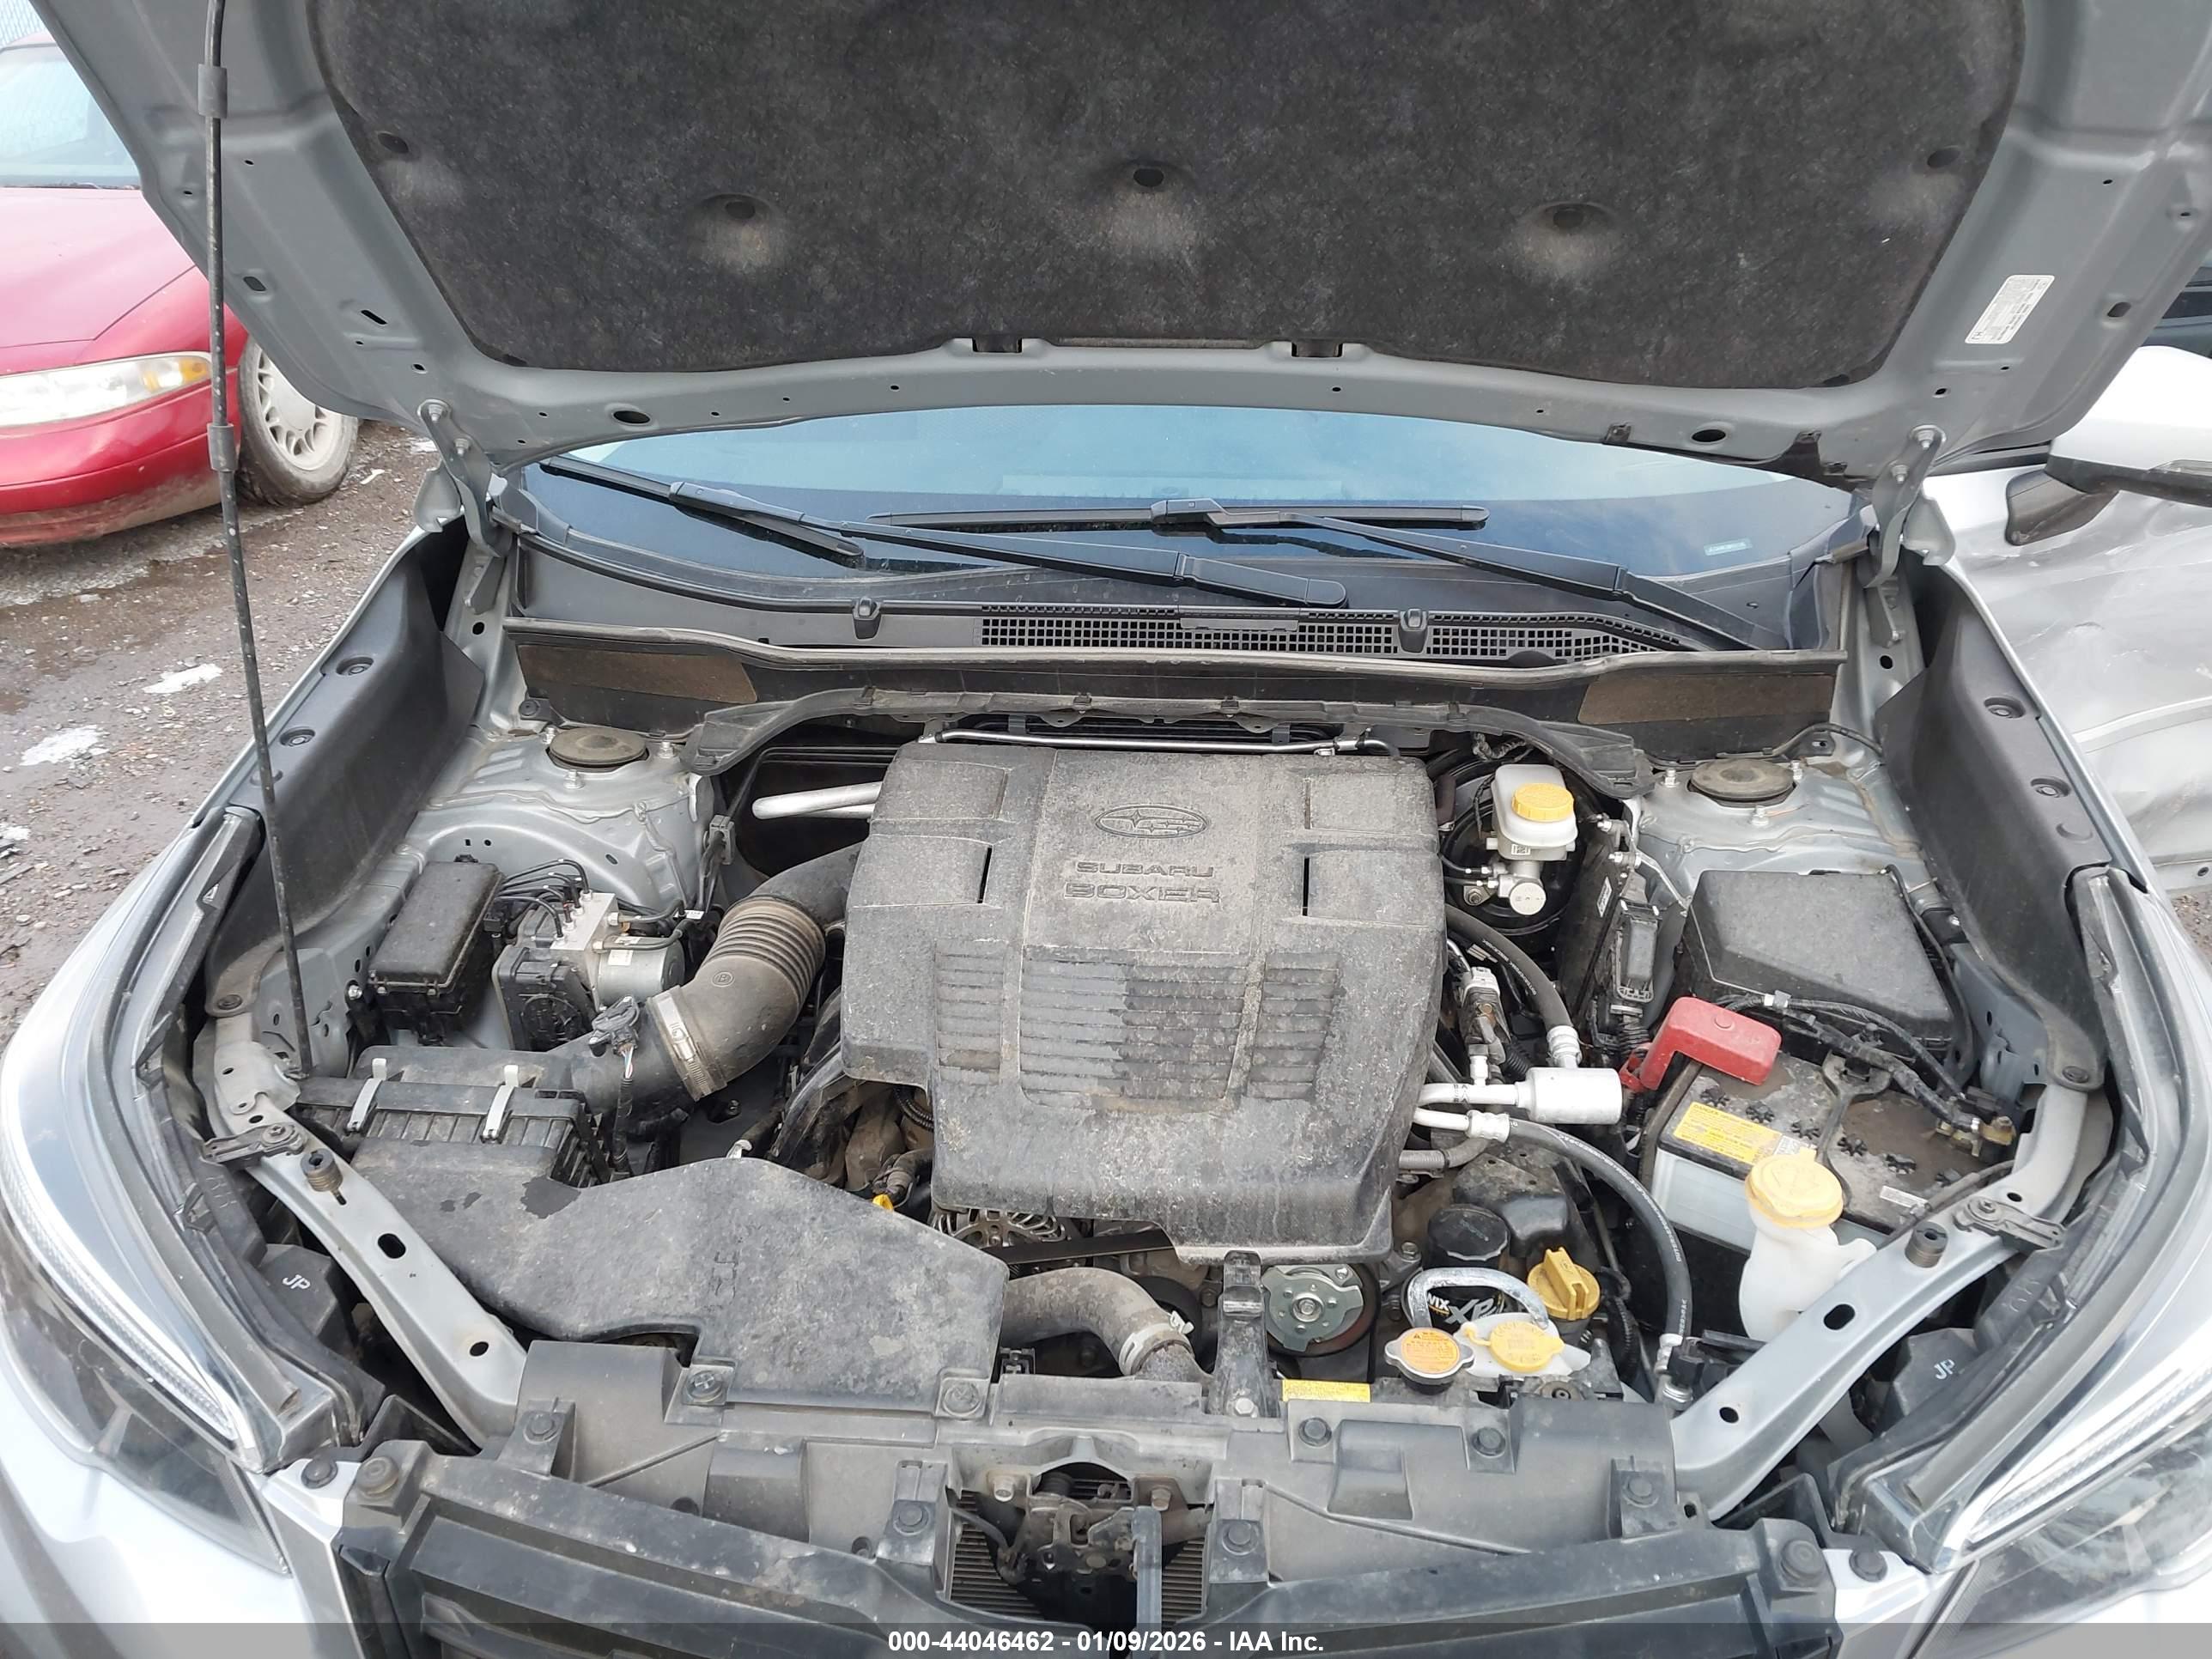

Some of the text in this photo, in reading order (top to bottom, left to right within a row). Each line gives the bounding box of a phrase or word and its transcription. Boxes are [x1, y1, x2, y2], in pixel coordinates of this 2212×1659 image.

[1075, 860, 1214, 878] SUBARU
[1063, 882, 1222, 903] BOXER
[282, 1274, 311, 1290] JP
[1443, 1297, 1495, 1325] XP
[1934, 1358, 1956, 1380] JP
